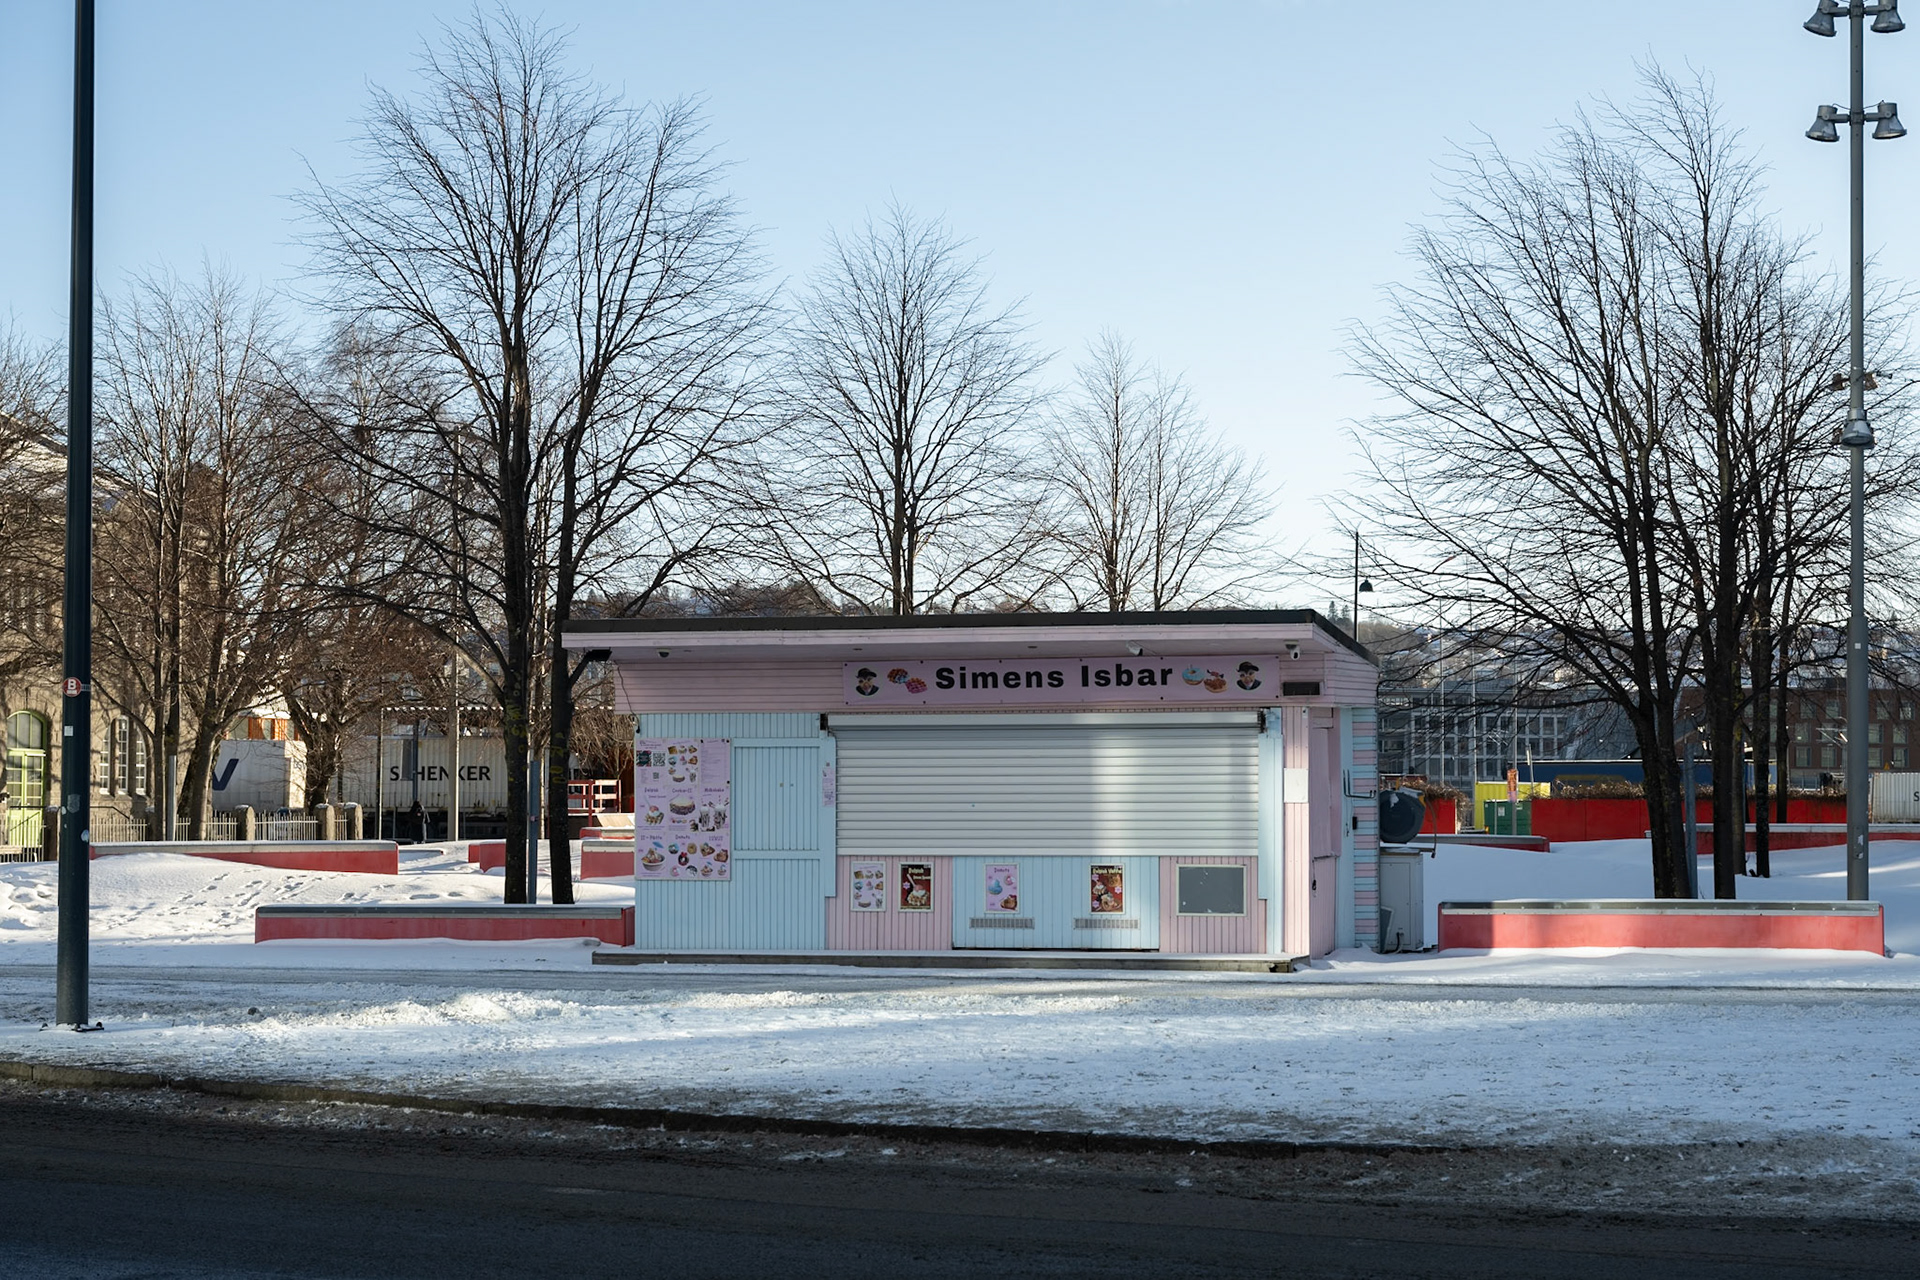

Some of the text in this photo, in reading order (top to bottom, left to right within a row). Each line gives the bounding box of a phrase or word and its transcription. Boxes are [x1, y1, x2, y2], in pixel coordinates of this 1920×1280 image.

[67, 678, 77, 690] B
[935, 663, 1173, 689] Simens Isbar
[390, 765, 491, 781] SHENKER
